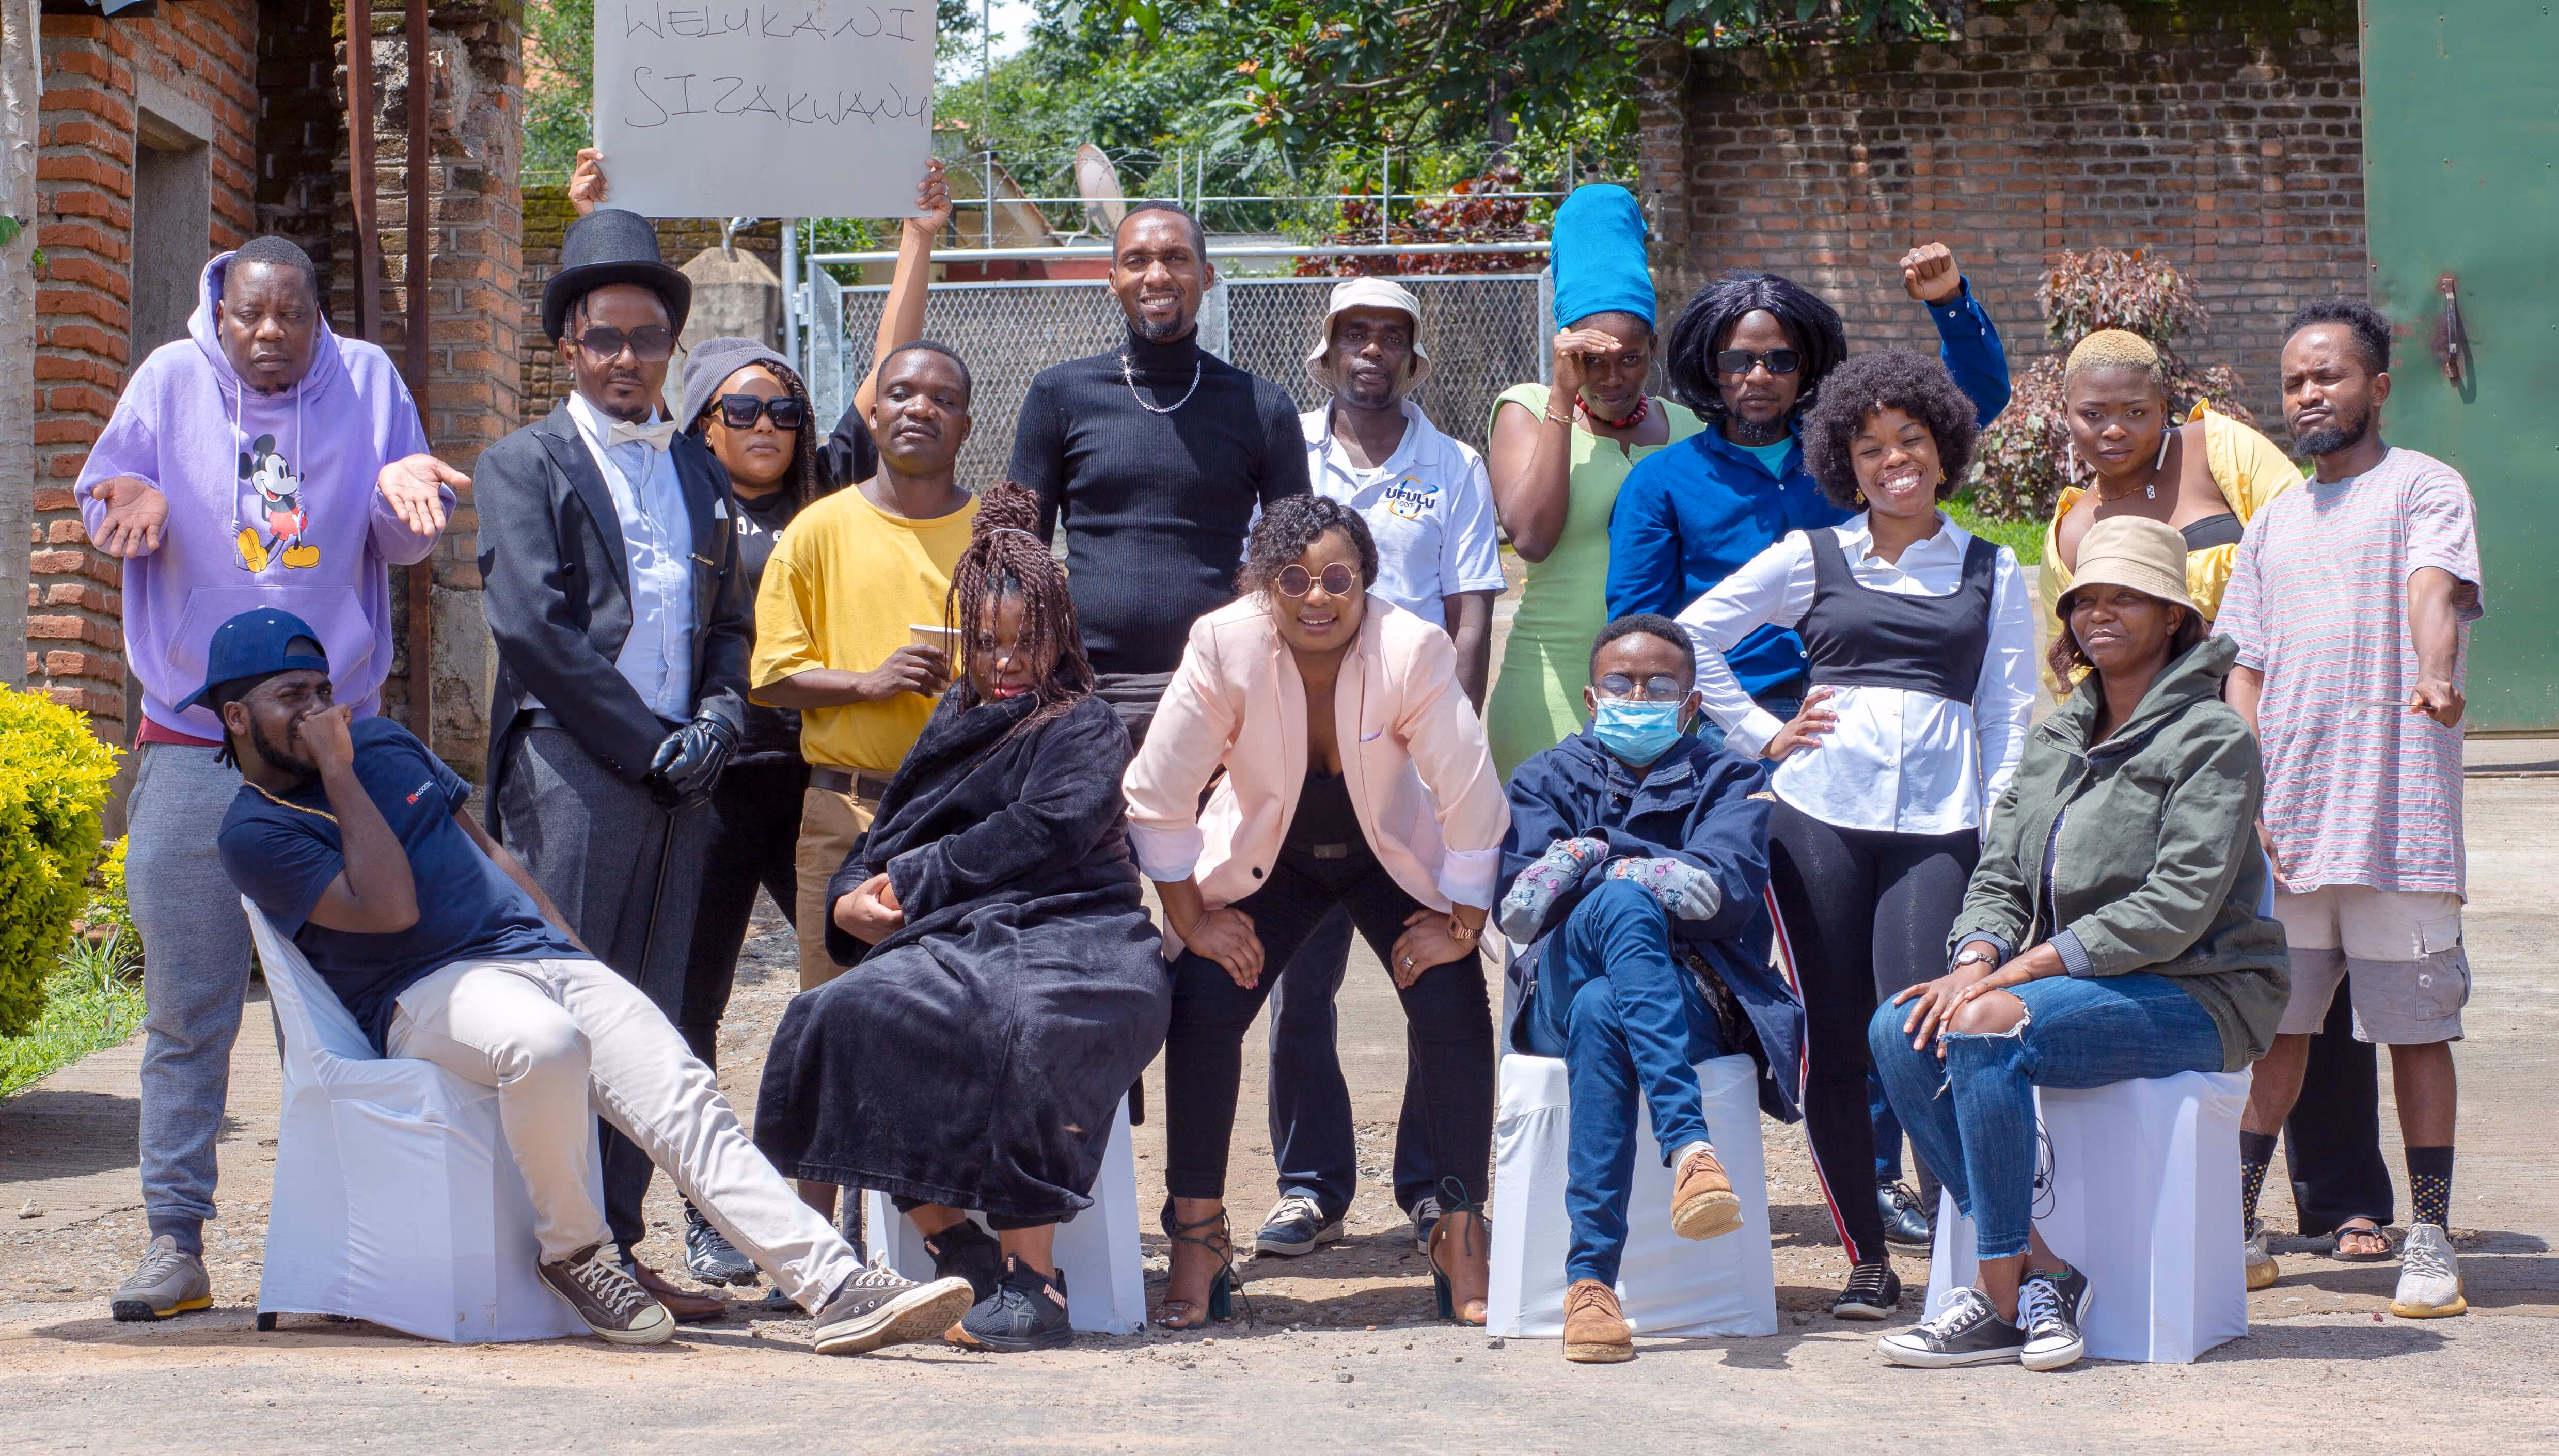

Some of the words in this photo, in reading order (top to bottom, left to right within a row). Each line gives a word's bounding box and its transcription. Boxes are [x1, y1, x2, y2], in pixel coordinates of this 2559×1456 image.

[625, 1, 915, 41] WELUKANI
[1385, 487, 1435, 509] UFULU
[1043, 1284, 1066, 1309] PUMA
